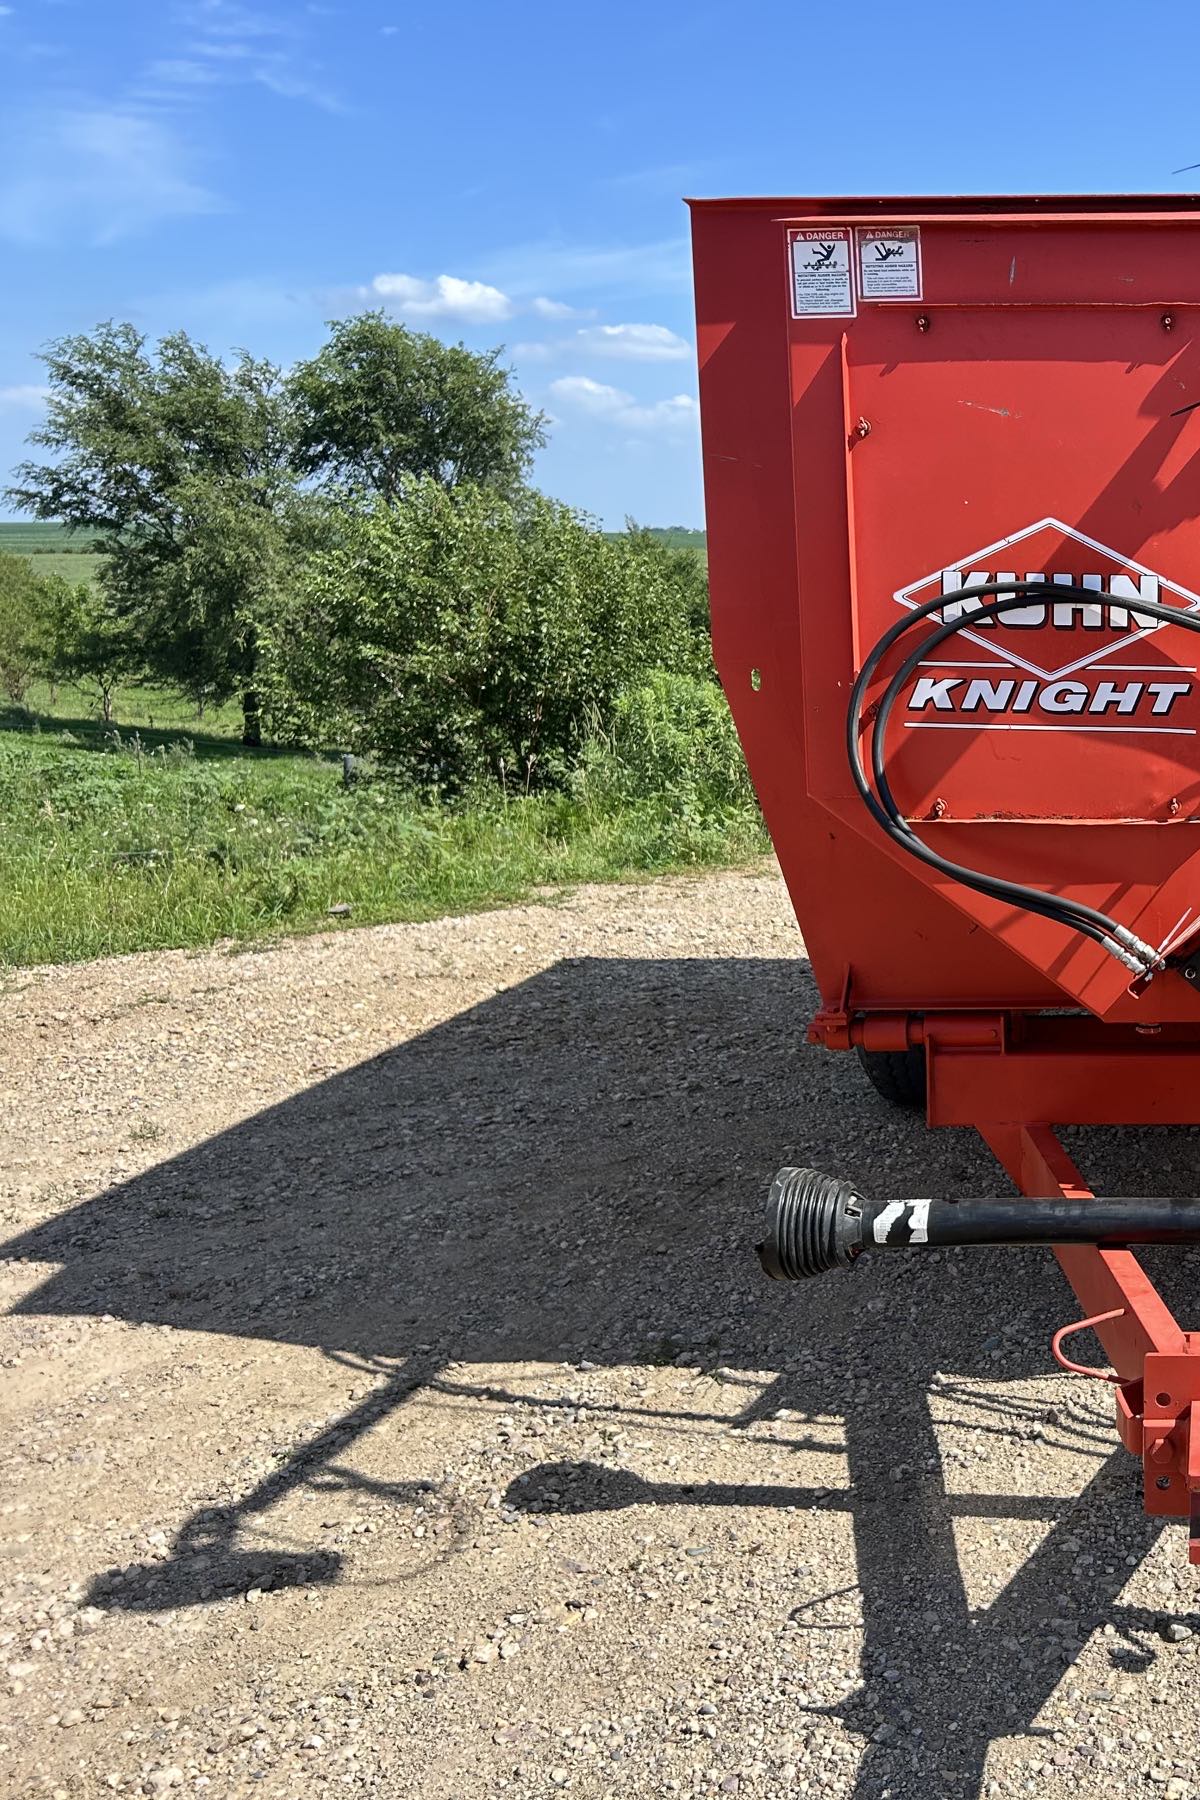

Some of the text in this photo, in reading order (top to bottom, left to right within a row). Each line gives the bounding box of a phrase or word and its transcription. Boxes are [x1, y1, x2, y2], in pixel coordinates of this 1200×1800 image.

[806, 231, 844, 240] DANGER
[941, 571, 1160, 629] KUHN
[907, 678, 1192, 714] KNIGHT
